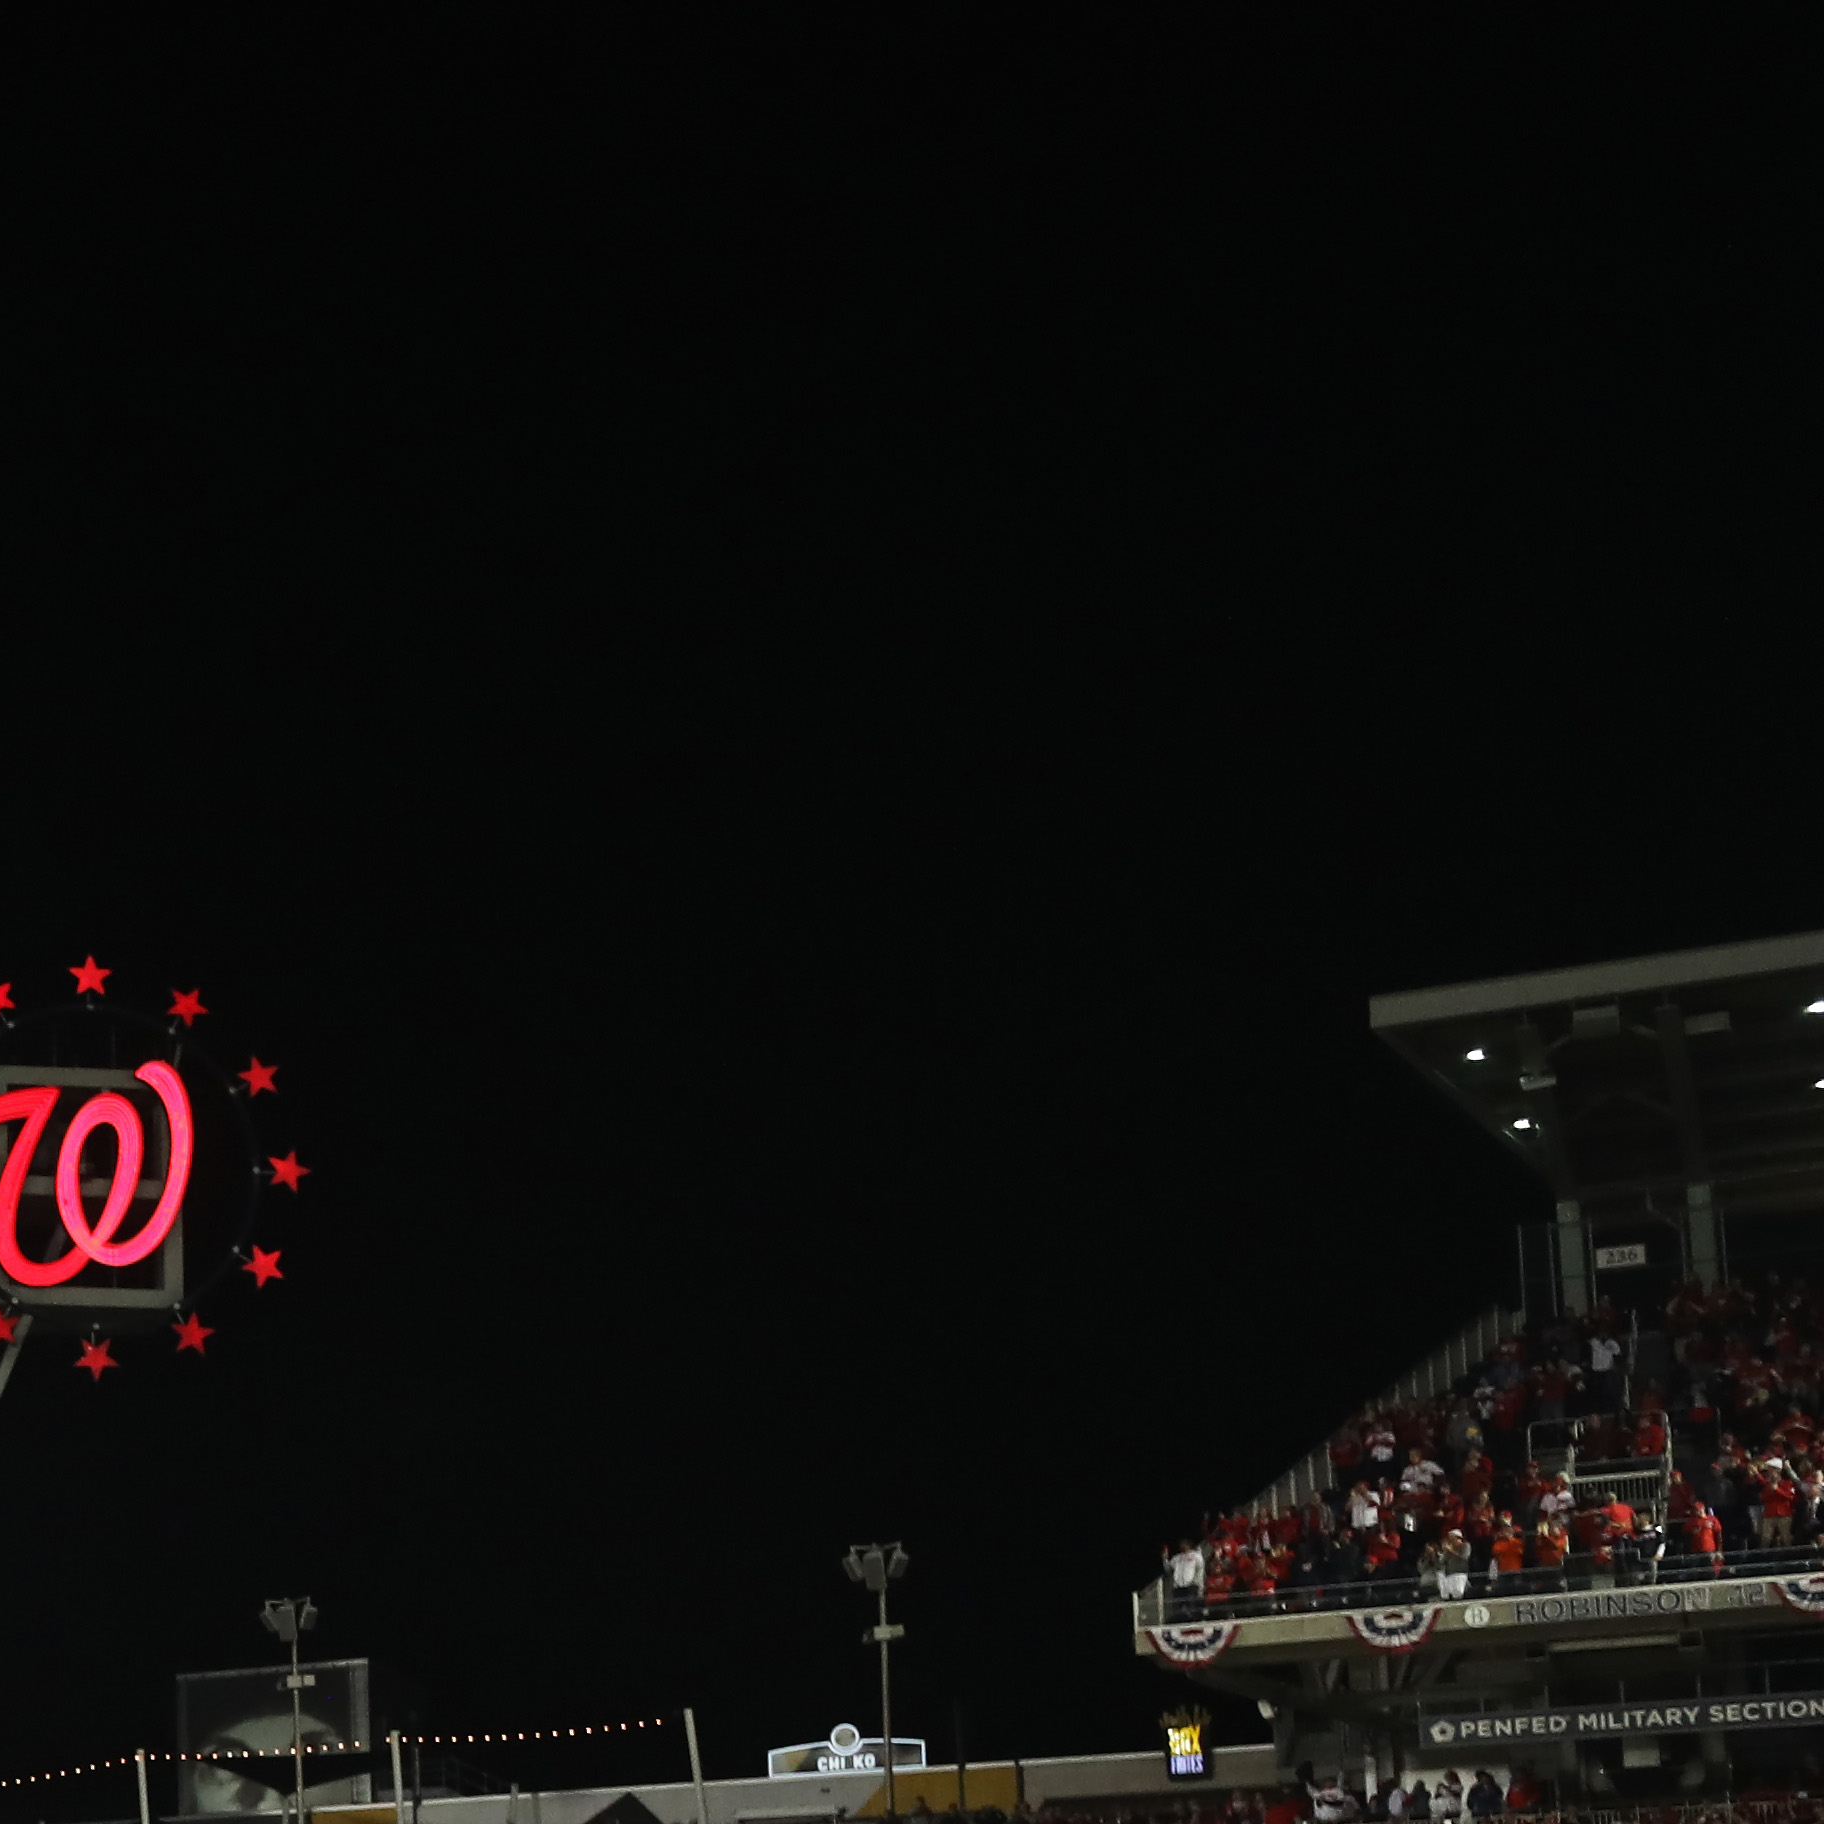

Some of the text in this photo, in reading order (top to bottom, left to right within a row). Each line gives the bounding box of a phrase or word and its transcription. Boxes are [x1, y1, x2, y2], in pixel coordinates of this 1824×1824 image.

[1514, 1588, 1710, 1624] ROBINSON
[1460, 1699, 1824, 1739] PENFED MILITARY SECTION
